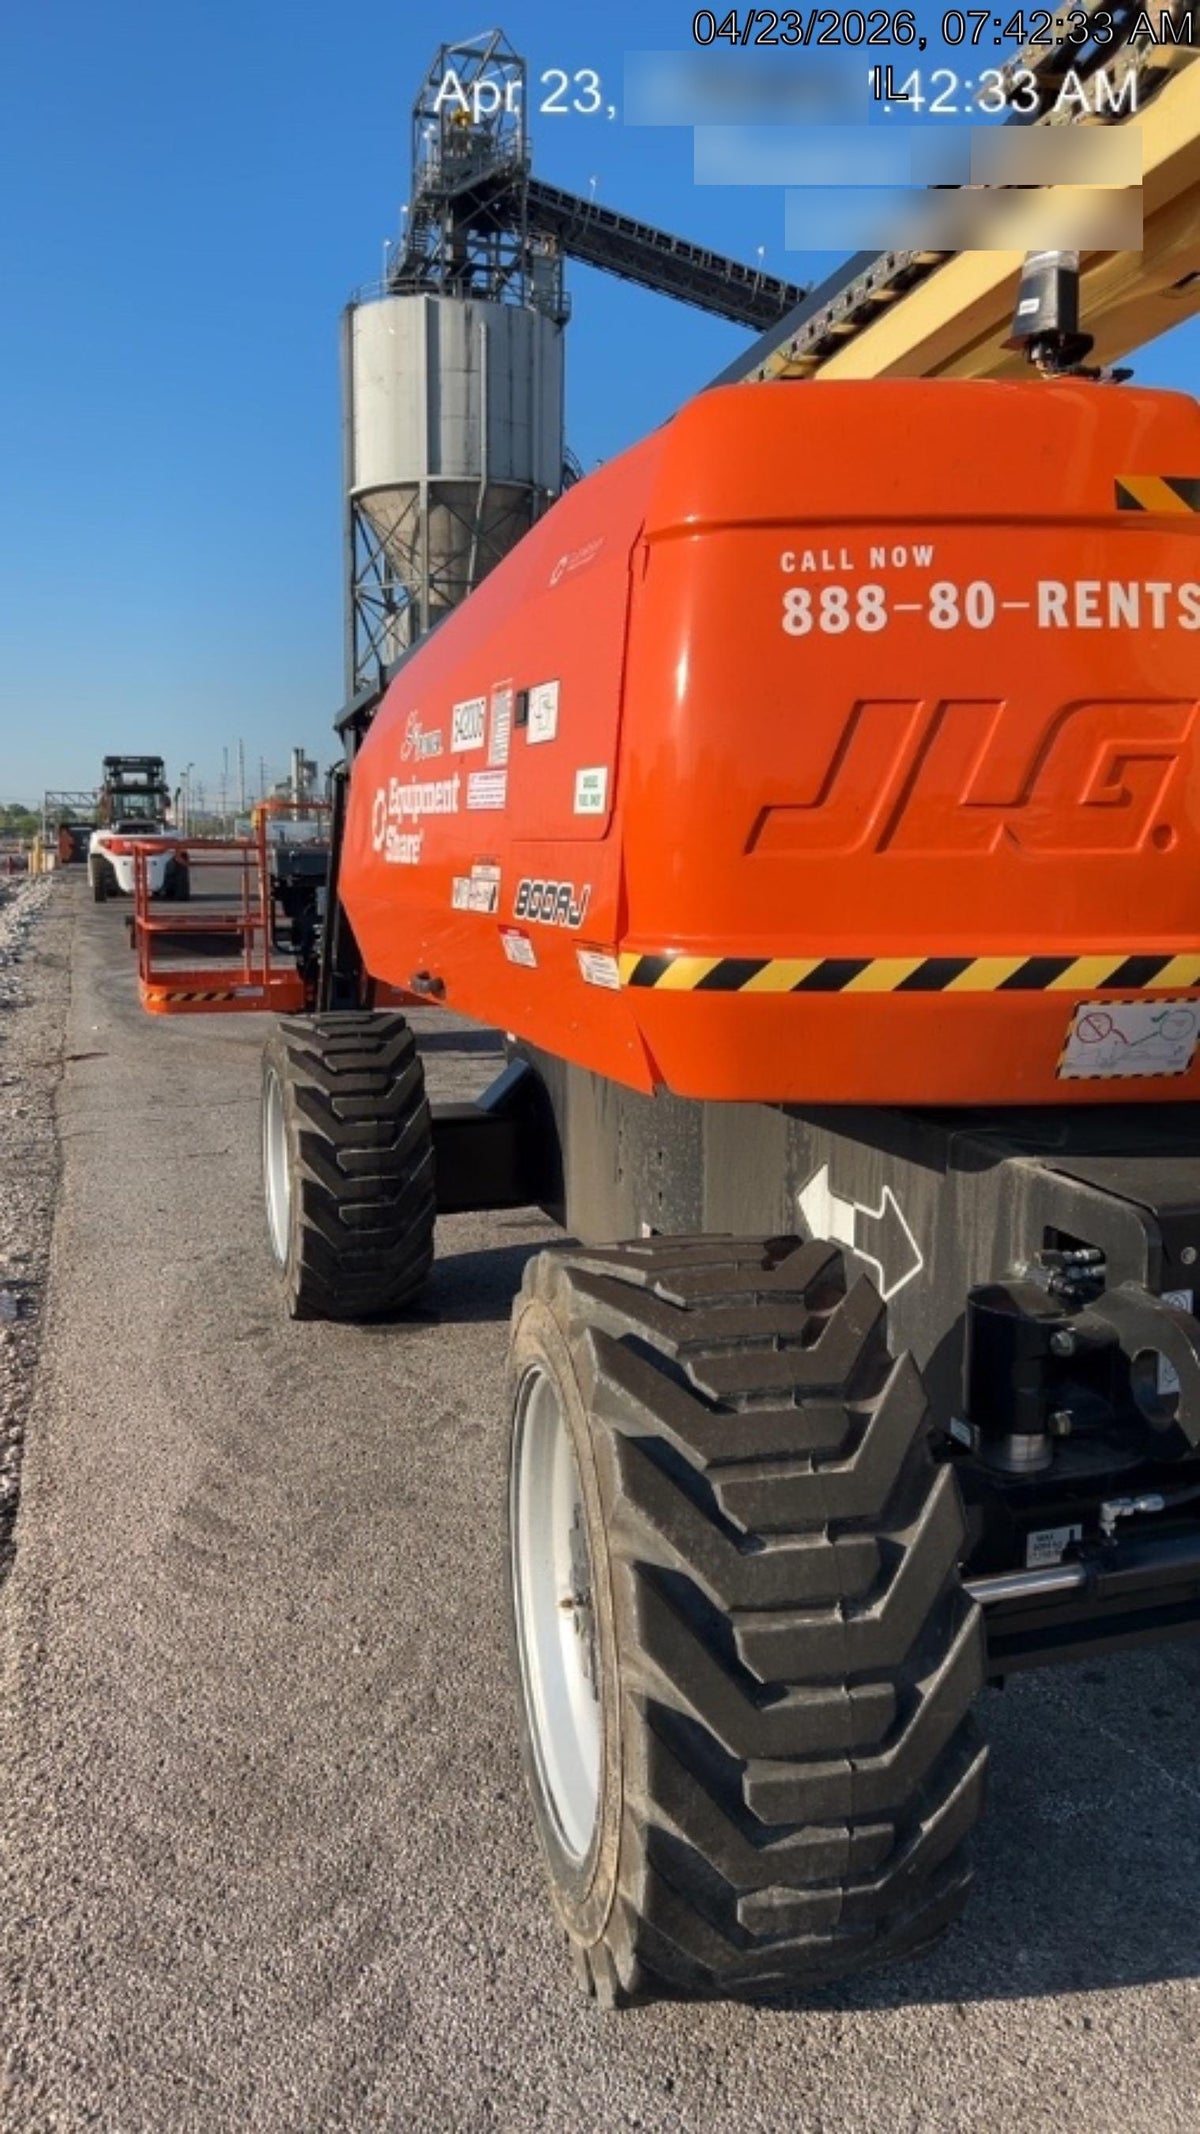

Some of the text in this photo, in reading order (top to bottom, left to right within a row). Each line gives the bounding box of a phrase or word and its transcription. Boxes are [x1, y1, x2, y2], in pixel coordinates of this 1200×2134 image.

[780, 545, 934, 572] CALL NOW
[781, 580, 1200, 636] 888-80-RENTS
[388, 773, 461, 824] Equipment
[384, 824, 424, 864] Share
[514, 878, 591, 930] 800AJ
